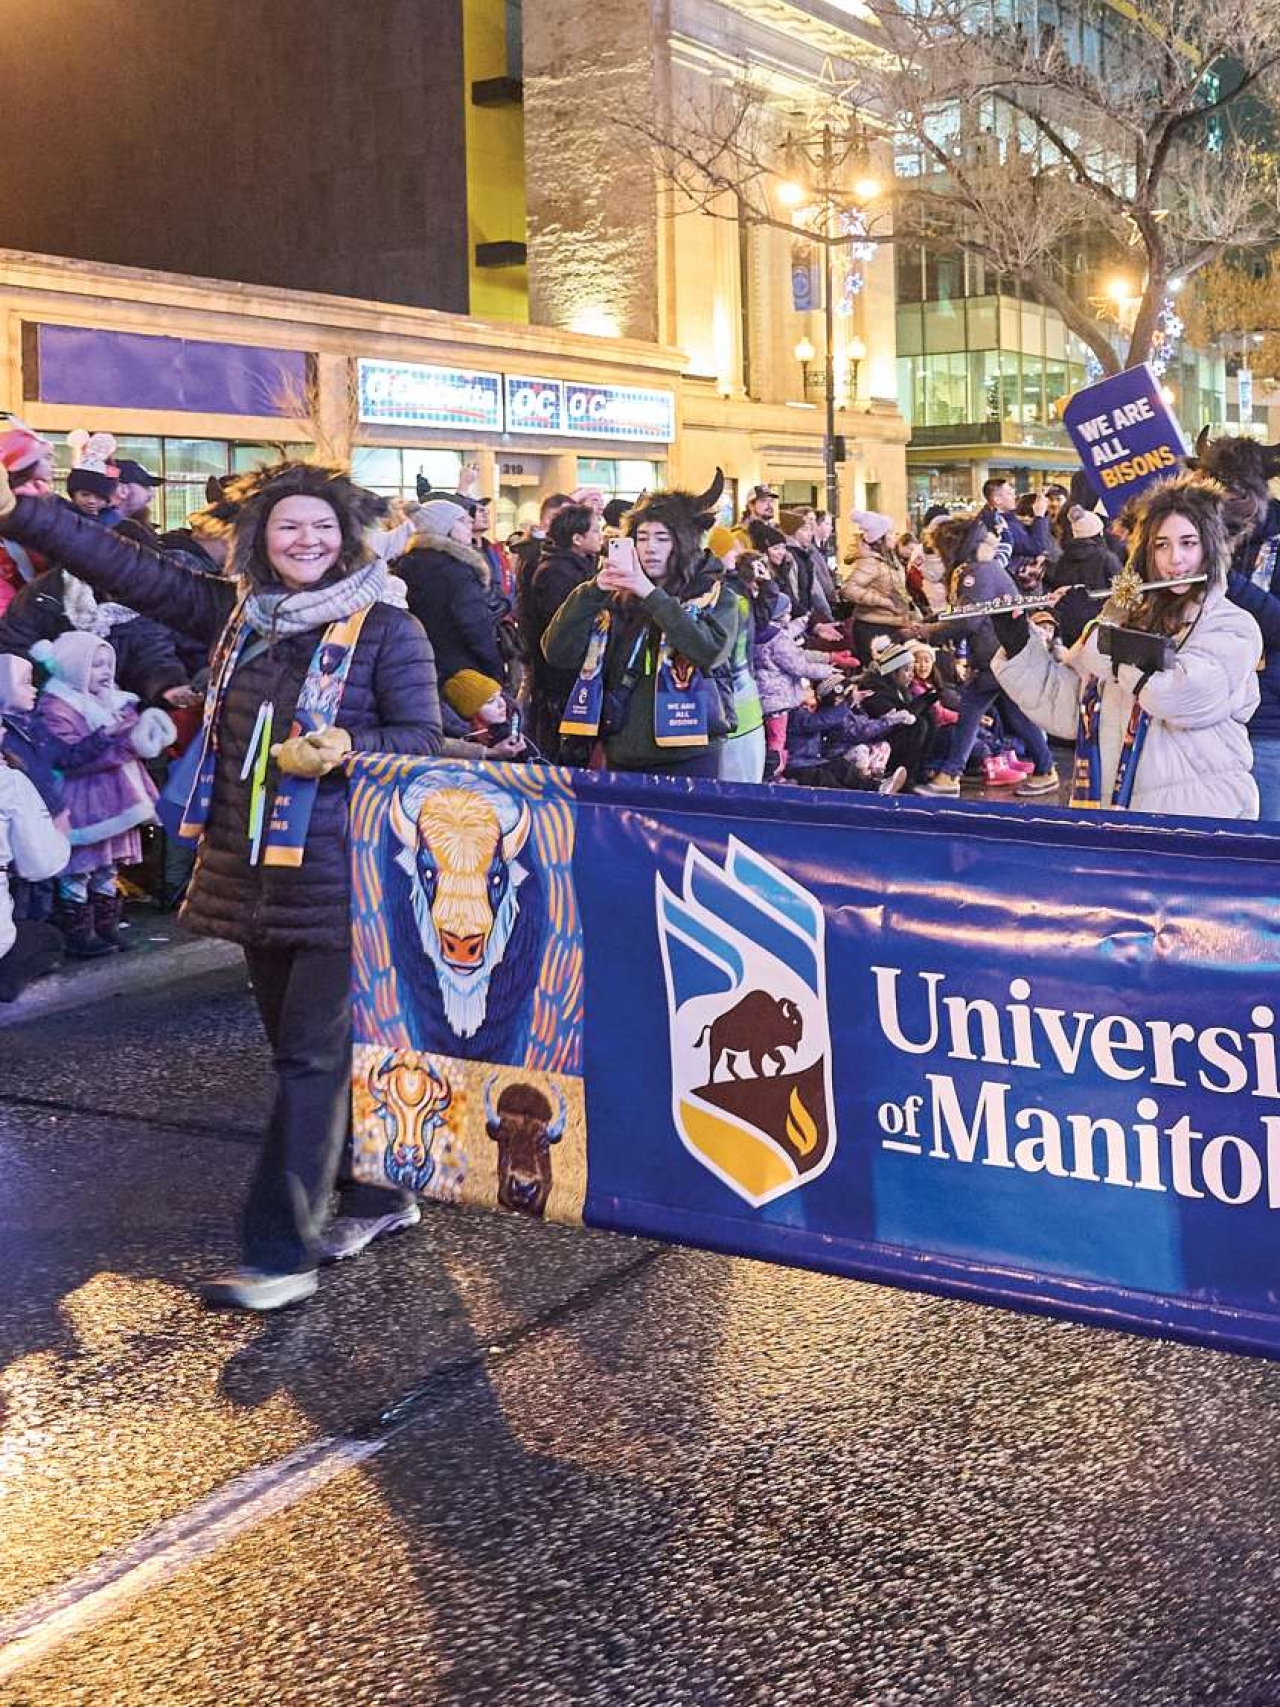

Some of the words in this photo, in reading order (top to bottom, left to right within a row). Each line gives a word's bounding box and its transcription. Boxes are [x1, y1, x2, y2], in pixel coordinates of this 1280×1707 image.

[1076, 414, 1113, 442] WE
[1112, 397, 1155, 430] ARE
[1091, 438, 1131, 466] ALL
[1101, 446, 1175, 489] BISONS
[877, 1095, 924, 1140] of
